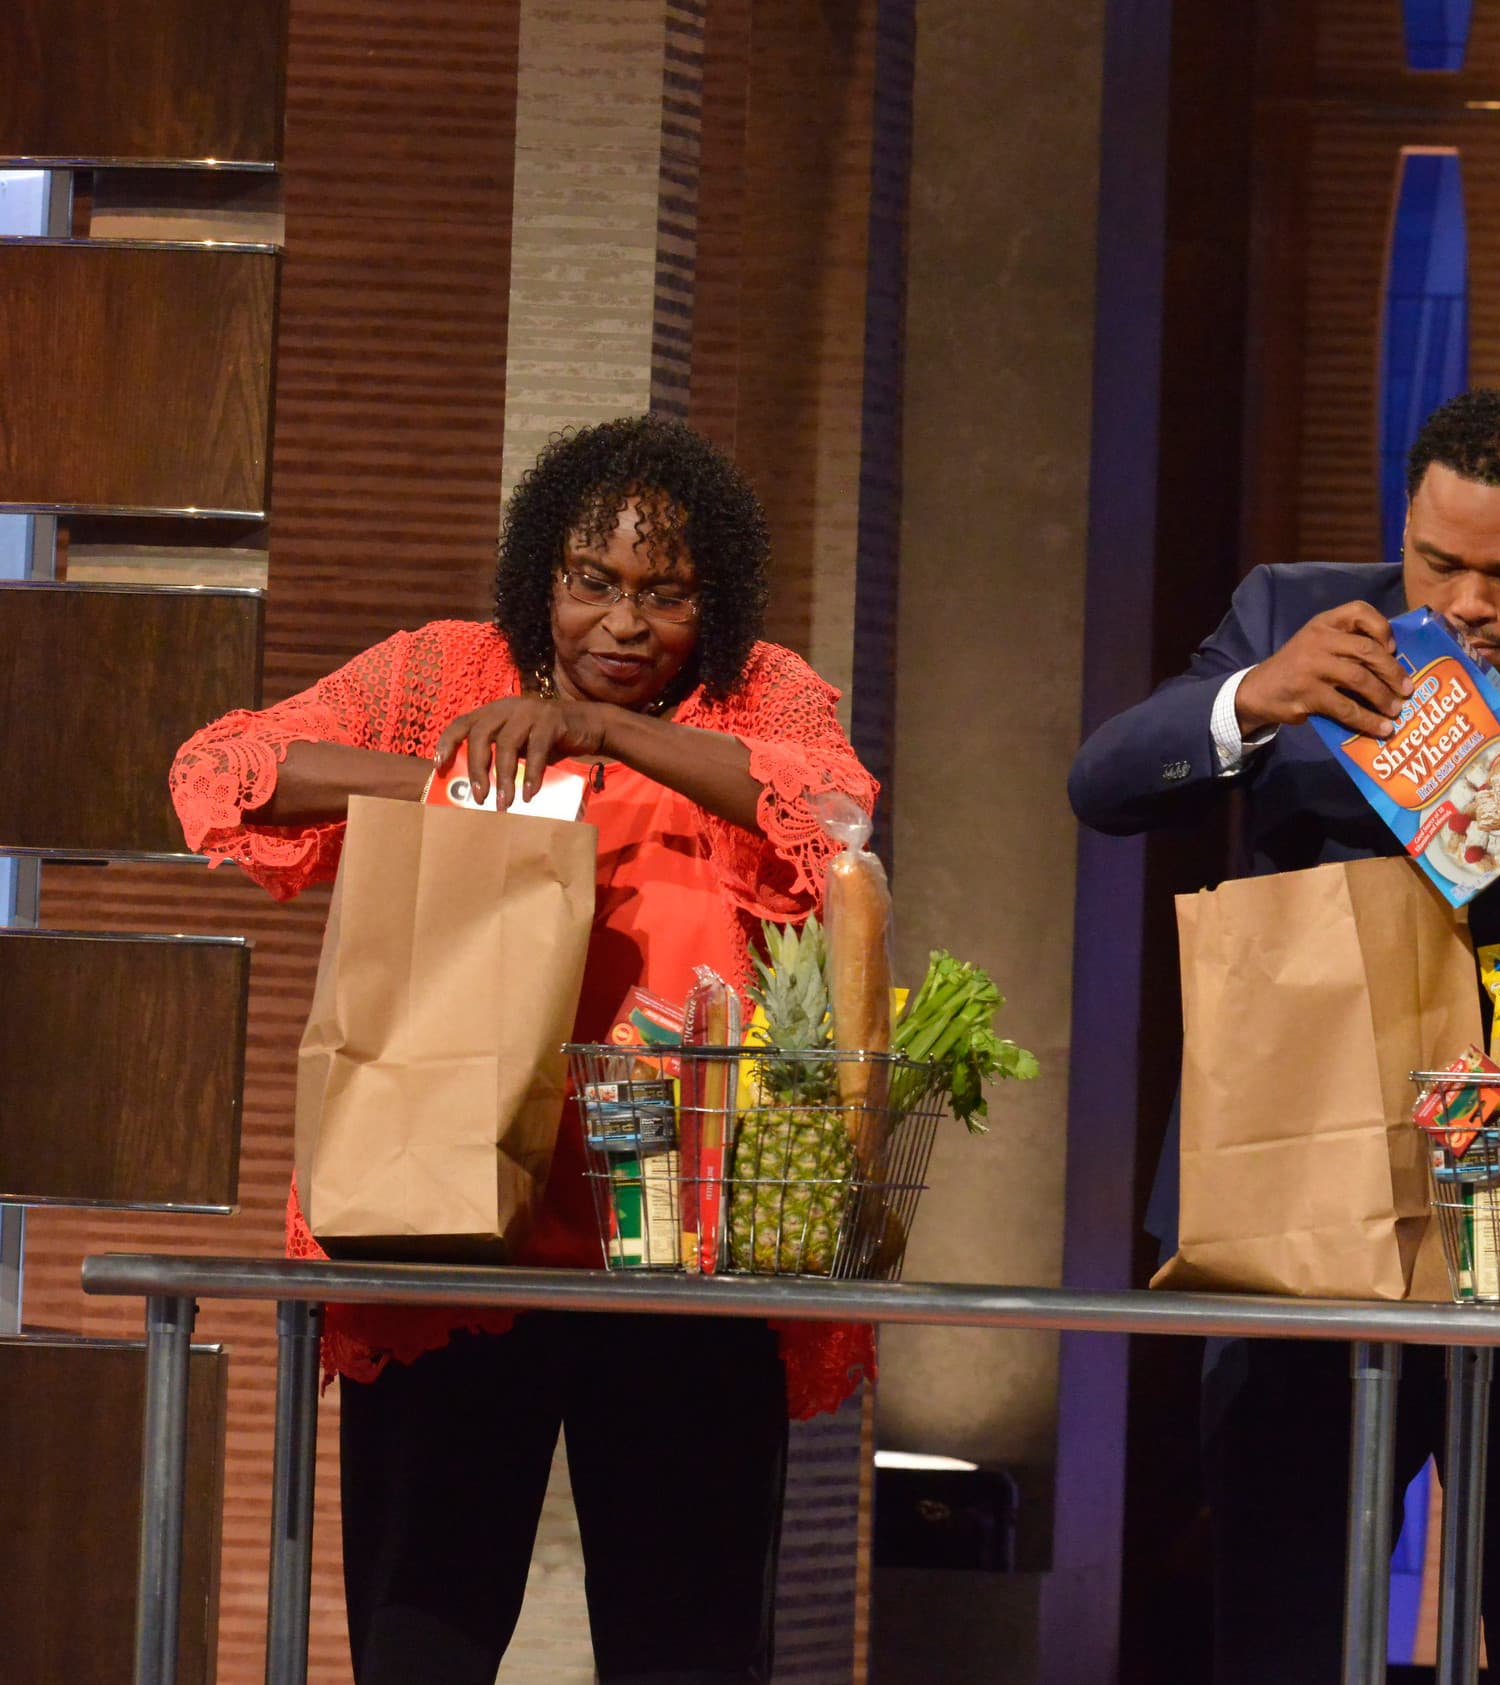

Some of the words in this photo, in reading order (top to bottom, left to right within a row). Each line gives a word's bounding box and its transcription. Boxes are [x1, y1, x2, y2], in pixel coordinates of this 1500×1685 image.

[1372, 677, 1467, 779] Shredded
[1377, 676, 1439, 748] OSTED
[1399, 714, 1470, 785] Wheat
[684, 999, 697, 1045] TUCCINE
